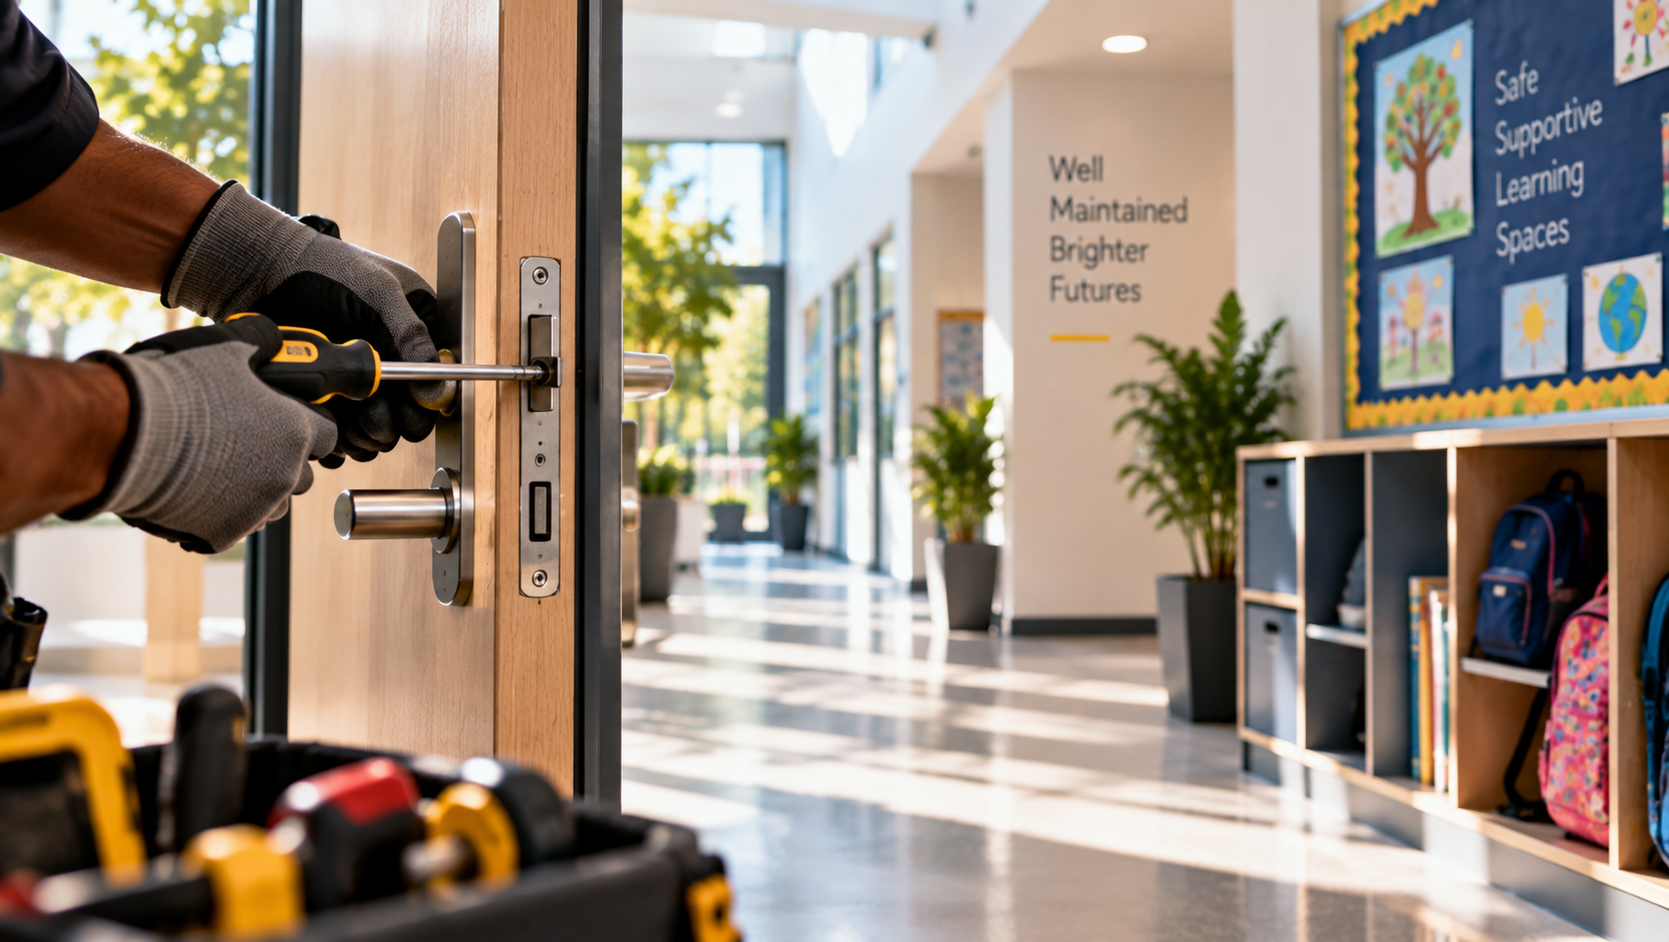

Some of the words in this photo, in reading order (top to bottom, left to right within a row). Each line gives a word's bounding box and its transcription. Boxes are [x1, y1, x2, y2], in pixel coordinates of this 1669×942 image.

[1495, 61, 1539, 106] Safe
[1495, 97, 1603, 158] Supportive
[1049, 156, 1104, 183] Well
[1495, 159, 1584, 207] Learning
[1050, 196, 1188, 223] Maintained
[1050, 235, 1149, 269] Brighter
[1495, 218, 1570, 264] Spaces
[1050, 275, 1142, 302] Futures
